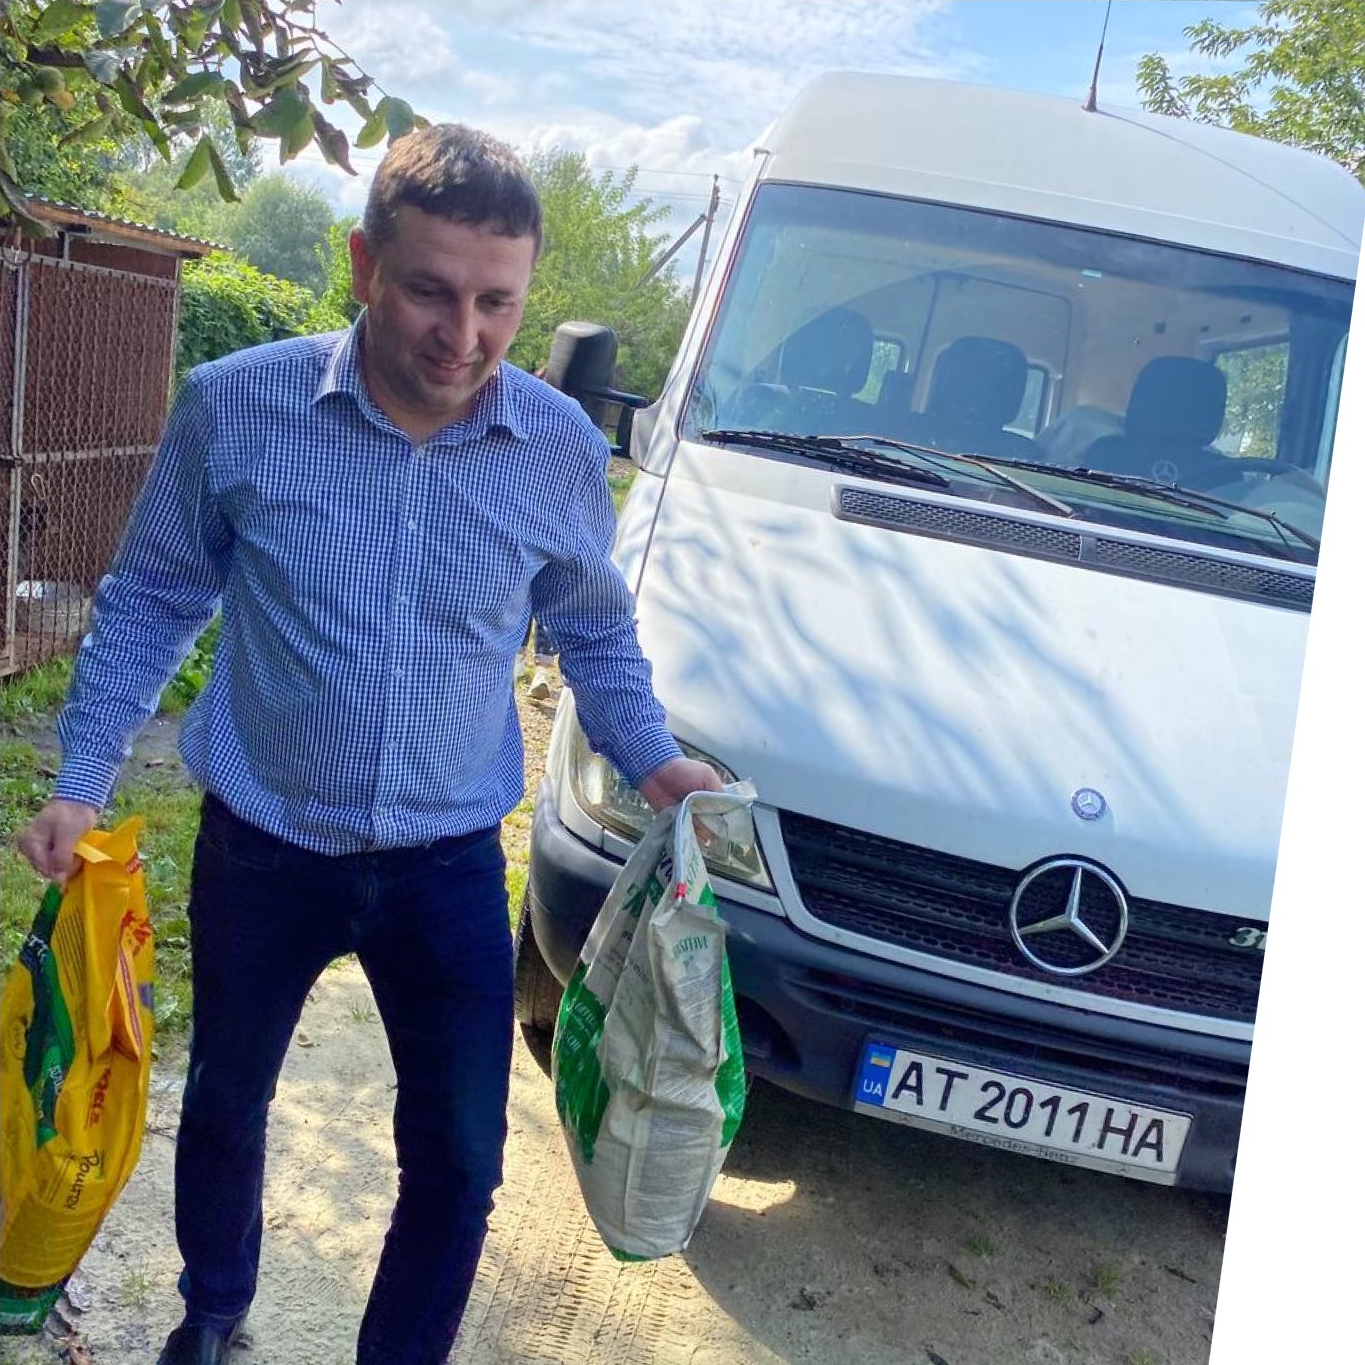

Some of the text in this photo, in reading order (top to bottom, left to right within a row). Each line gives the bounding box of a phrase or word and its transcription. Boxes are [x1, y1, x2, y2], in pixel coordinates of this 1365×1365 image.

[862, 1079, 884, 1098] UA
[891, 1060, 1165, 1163] AT 2011 HA
